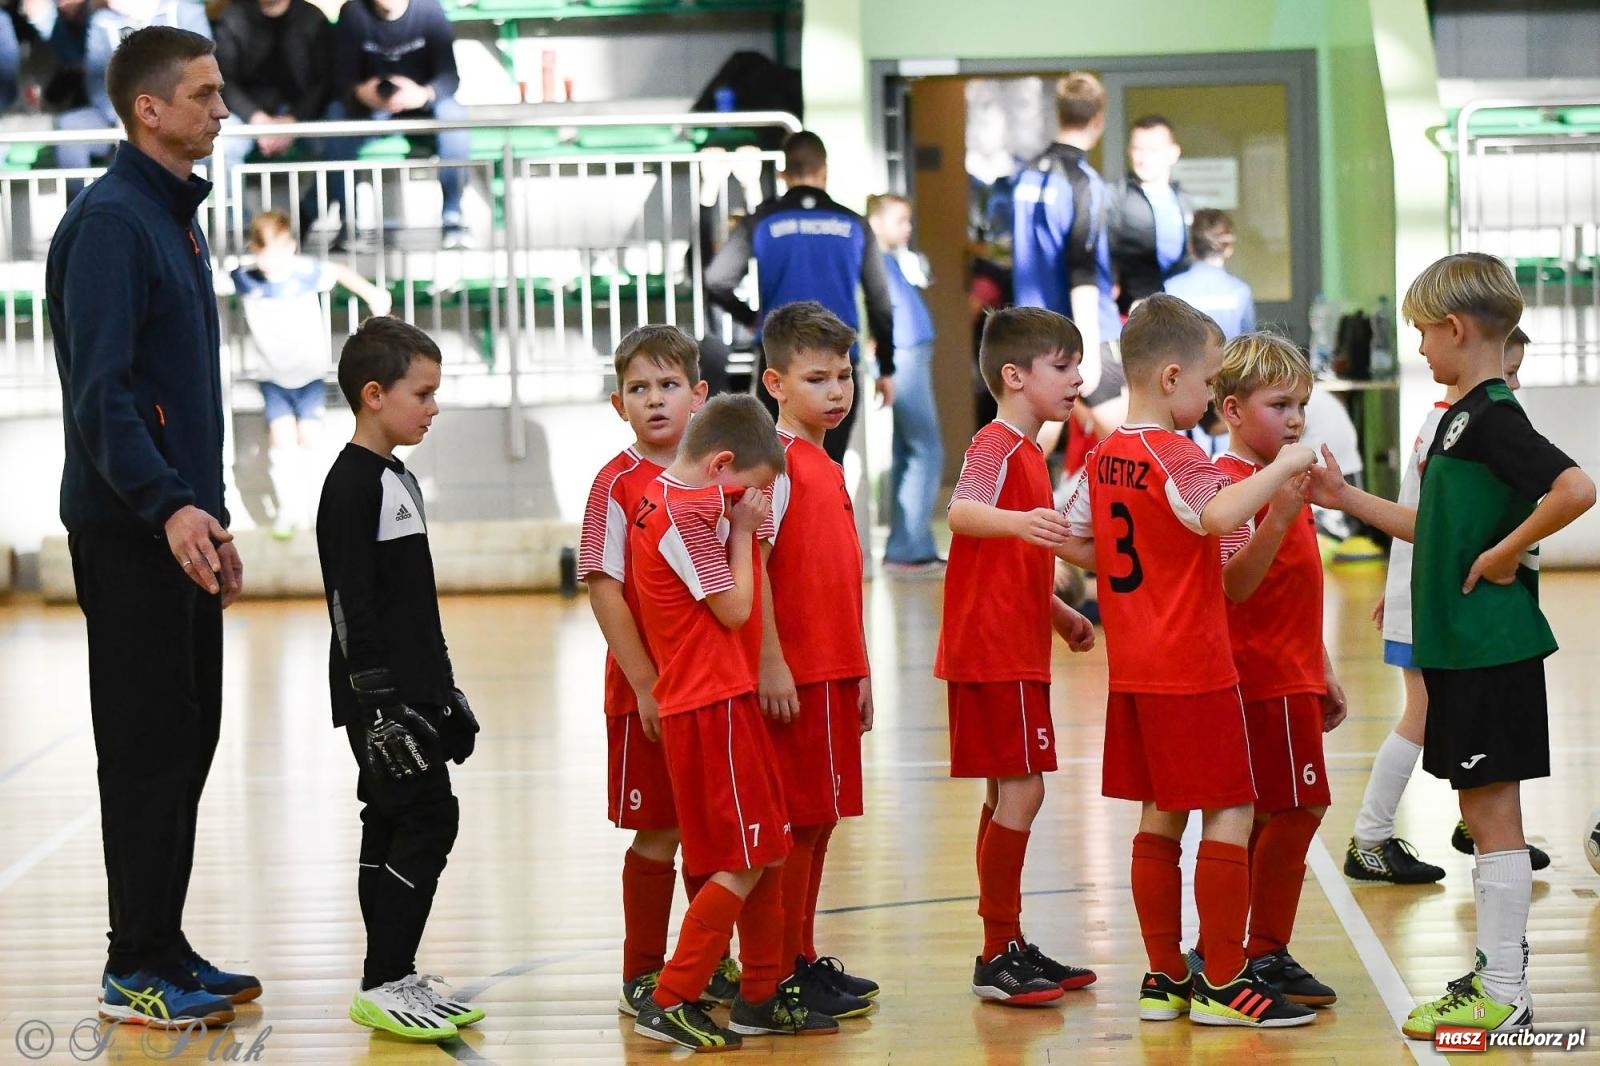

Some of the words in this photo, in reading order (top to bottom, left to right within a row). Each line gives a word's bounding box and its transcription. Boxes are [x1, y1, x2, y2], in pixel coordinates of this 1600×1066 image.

[1097, 455, 1150, 490] KIETRZ
[1108, 501, 1144, 594] 3
[1037, 727, 1050, 750] 5
[405, 738, 429, 771] reusch
[1302, 762, 1317, 786] 6
[629, 788, 642, 811] 9
[748, 823, 760, 848] 7
